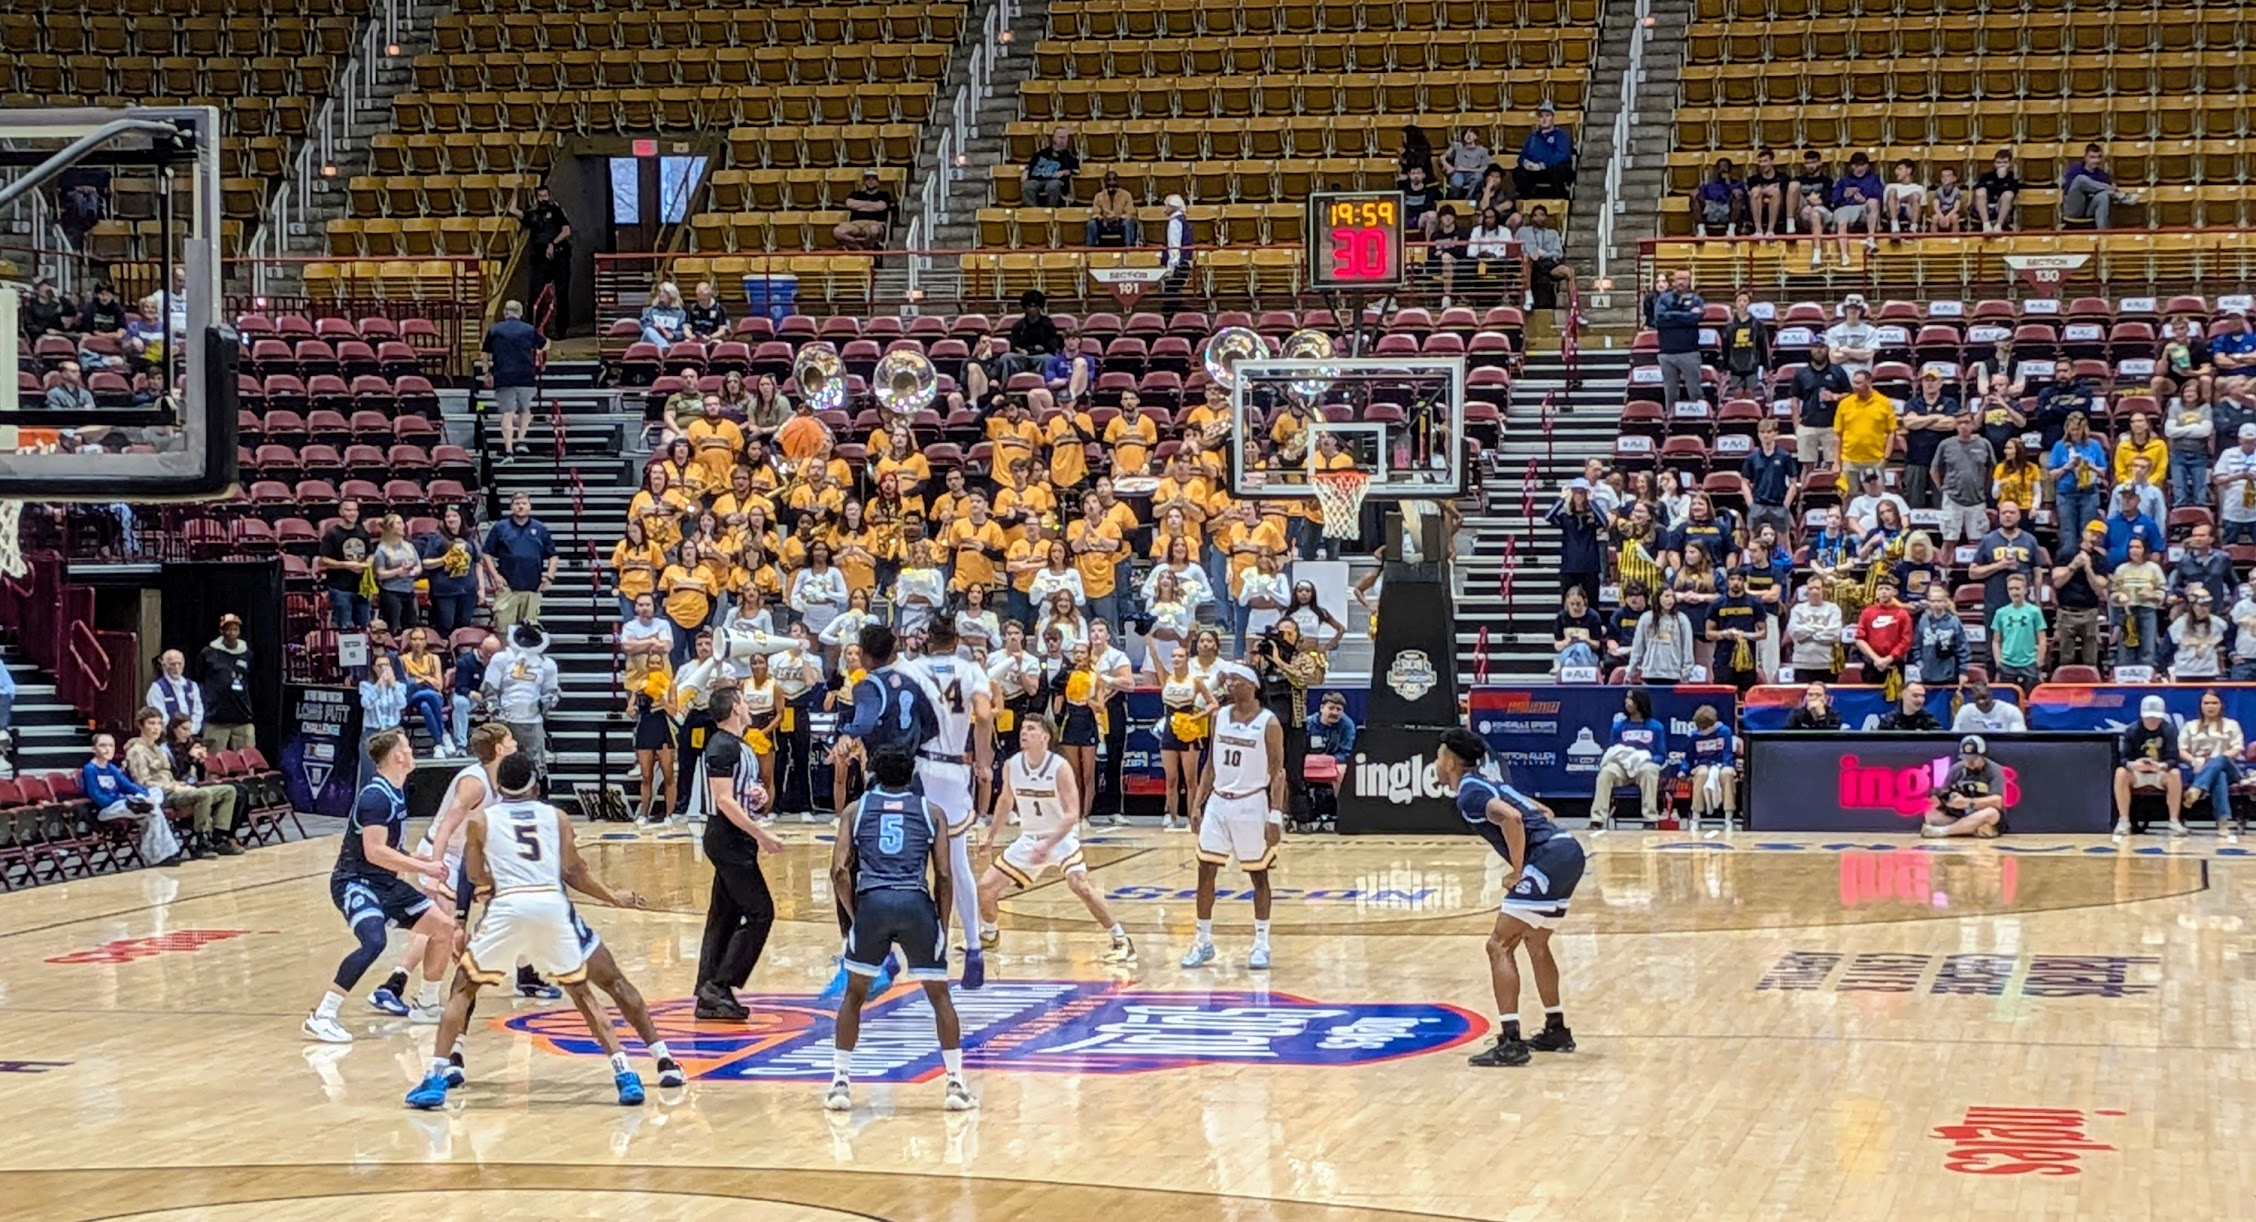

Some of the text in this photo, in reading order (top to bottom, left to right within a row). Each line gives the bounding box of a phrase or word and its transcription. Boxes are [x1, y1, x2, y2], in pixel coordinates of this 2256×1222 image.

[1331, 202, 1394, 227] 19:59
[1332, 228, 1387, 278] 30
[2026, 258, 2068, 266] SECTION
[1109, 272, 1148, 280] SECTION
[2035, 270, 2060, 282] 130
[1118, 283, 1139, 295] 101
[296, 701, 351, 724] LONG PUTT
[1222, 749, 1242, 767] 10
[1355, 752, 1457, 805] ingle
[1032, 800, 1043, 817] 1
[513, 824, 542, 862] 5
[878, 812, 905, 855] 5
[1315, 1016, 1443, 1050] ingles
[1928, 1106, 2127, 1176] ingles
